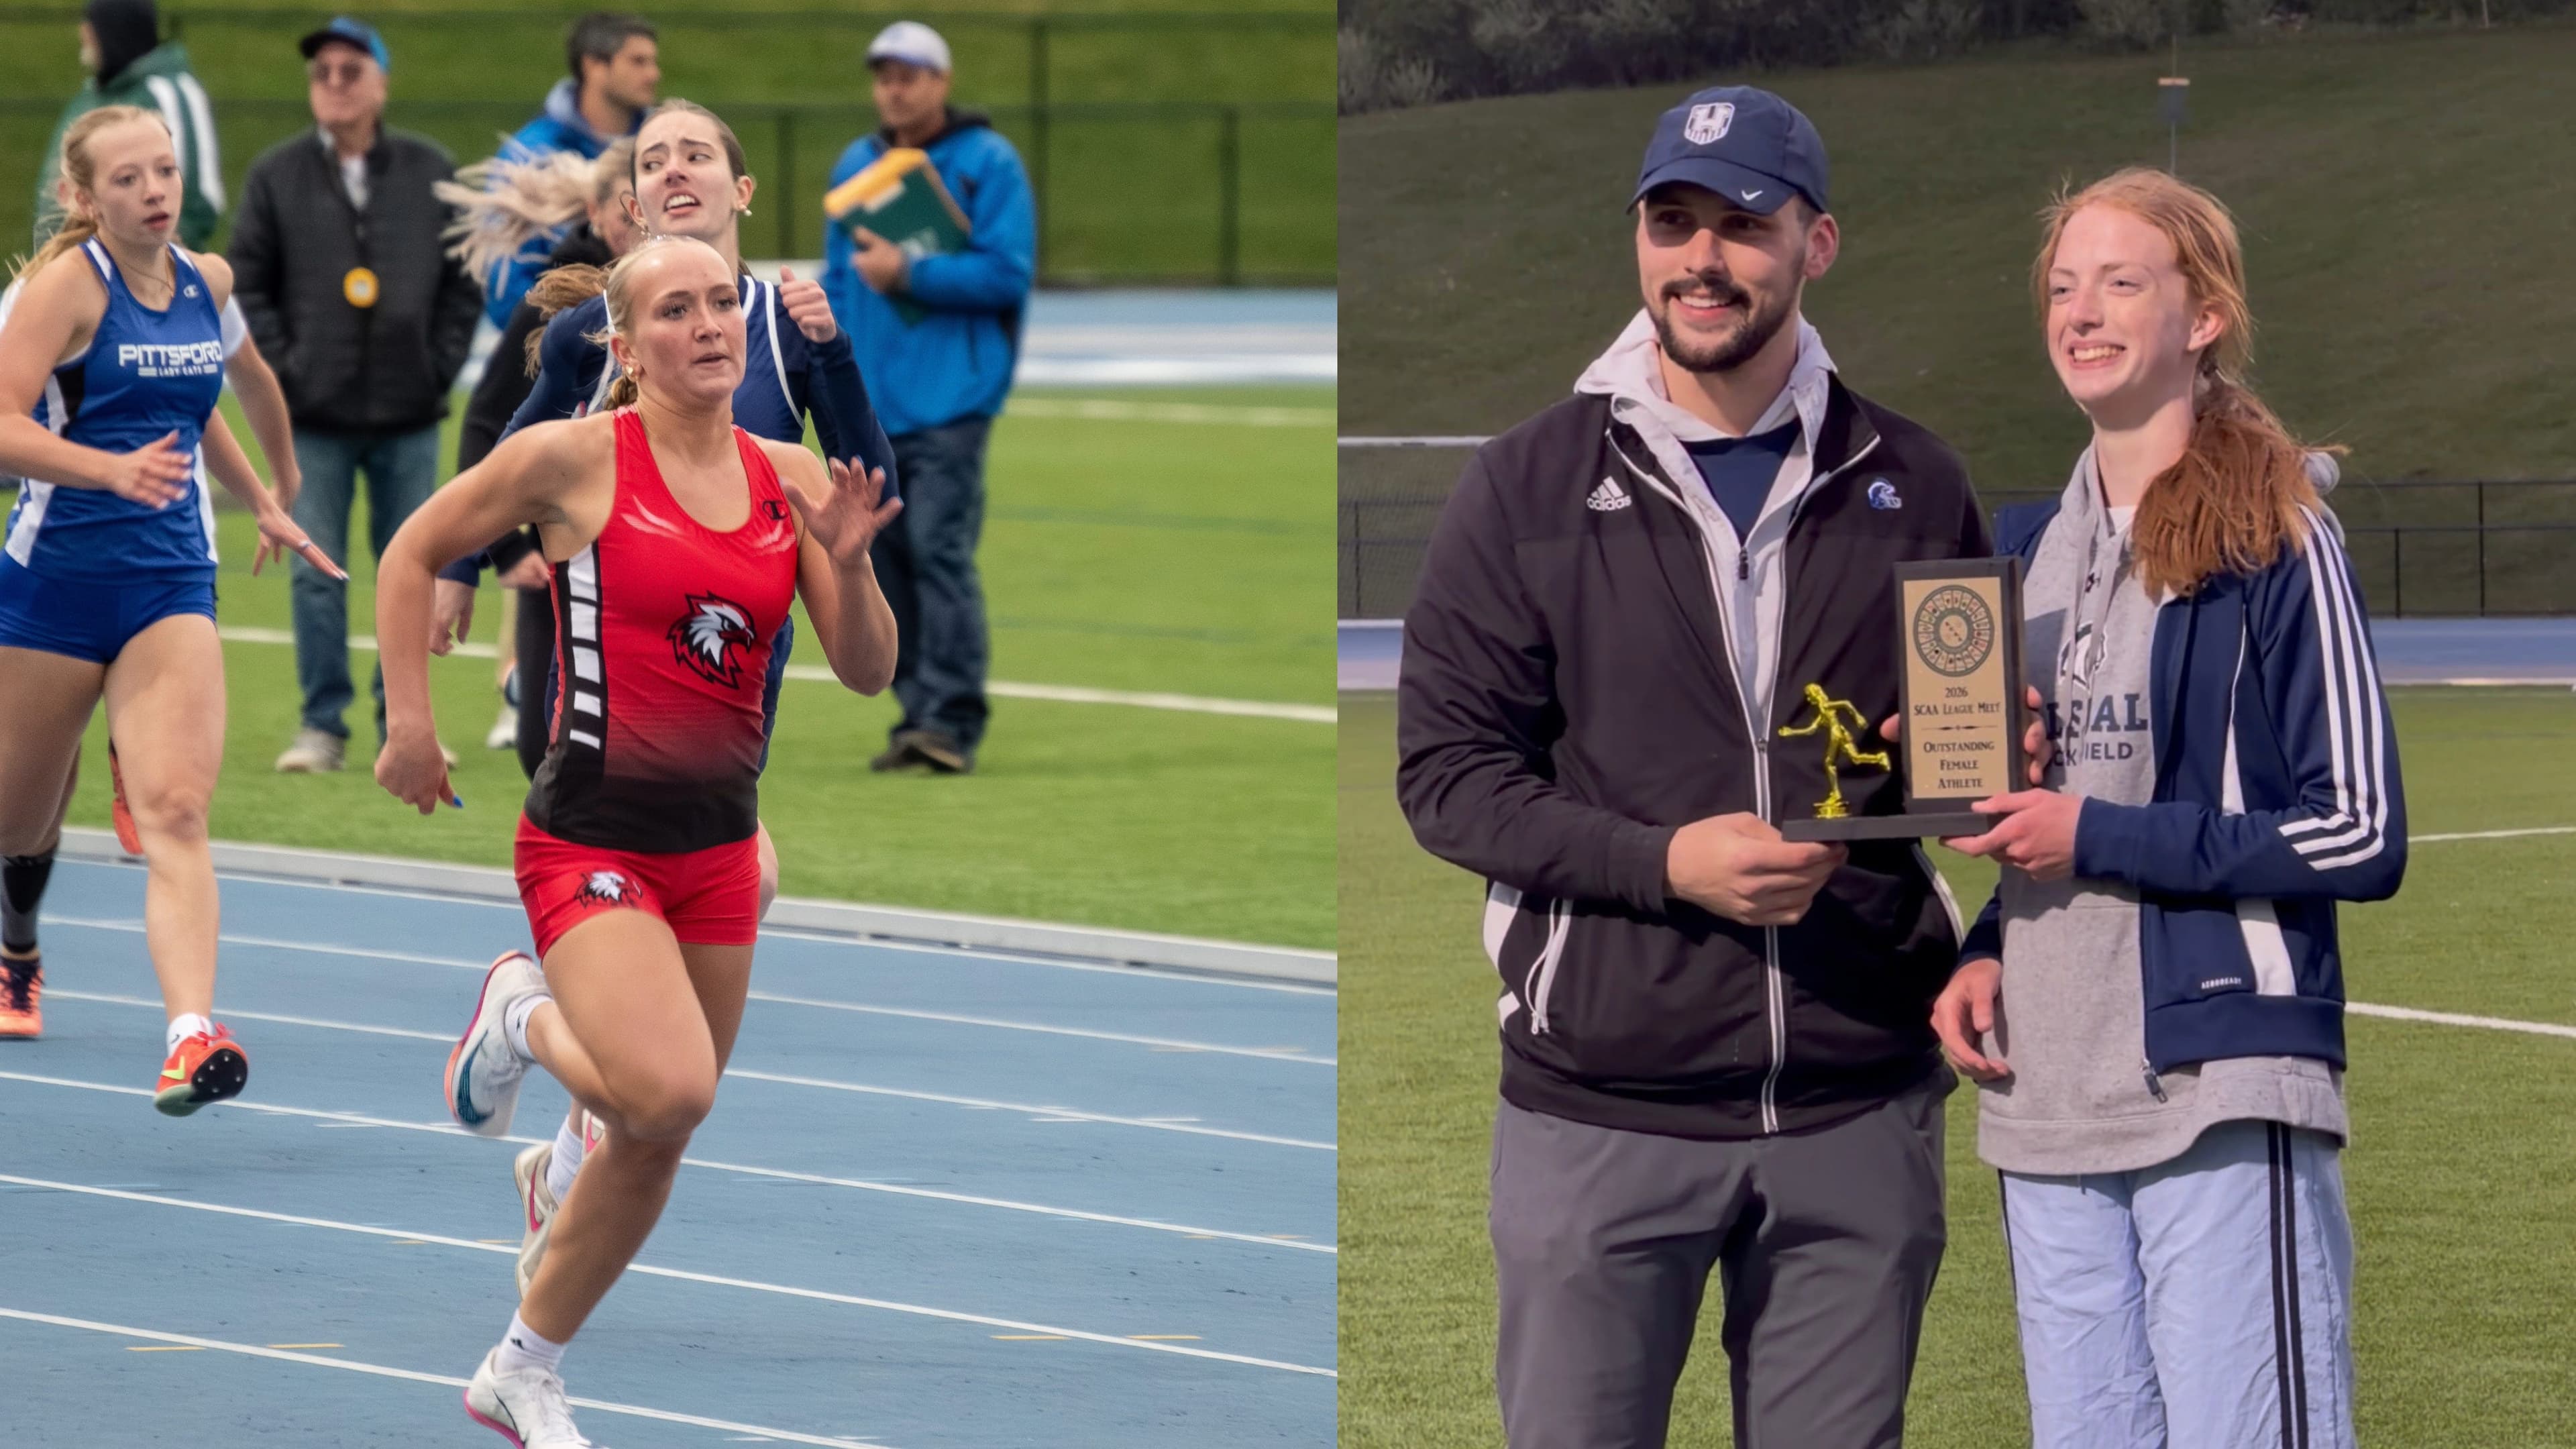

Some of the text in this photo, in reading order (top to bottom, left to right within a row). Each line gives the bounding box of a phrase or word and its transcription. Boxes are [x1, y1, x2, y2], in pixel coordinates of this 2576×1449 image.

[119, 340, 223, 367] PITTSFORD
[1587, 495, 1632, 511] adidas
[1945, 687, 1968, 698] 2026
[1915, 702, 2001, 715] SCAA LEAGUE MEET
[1923, 741, 1995, 753] OUTSTANDING
[1939, 759, 1979, 771] FEMALE
[1938, 778, 1983, 789] ATHLETE
